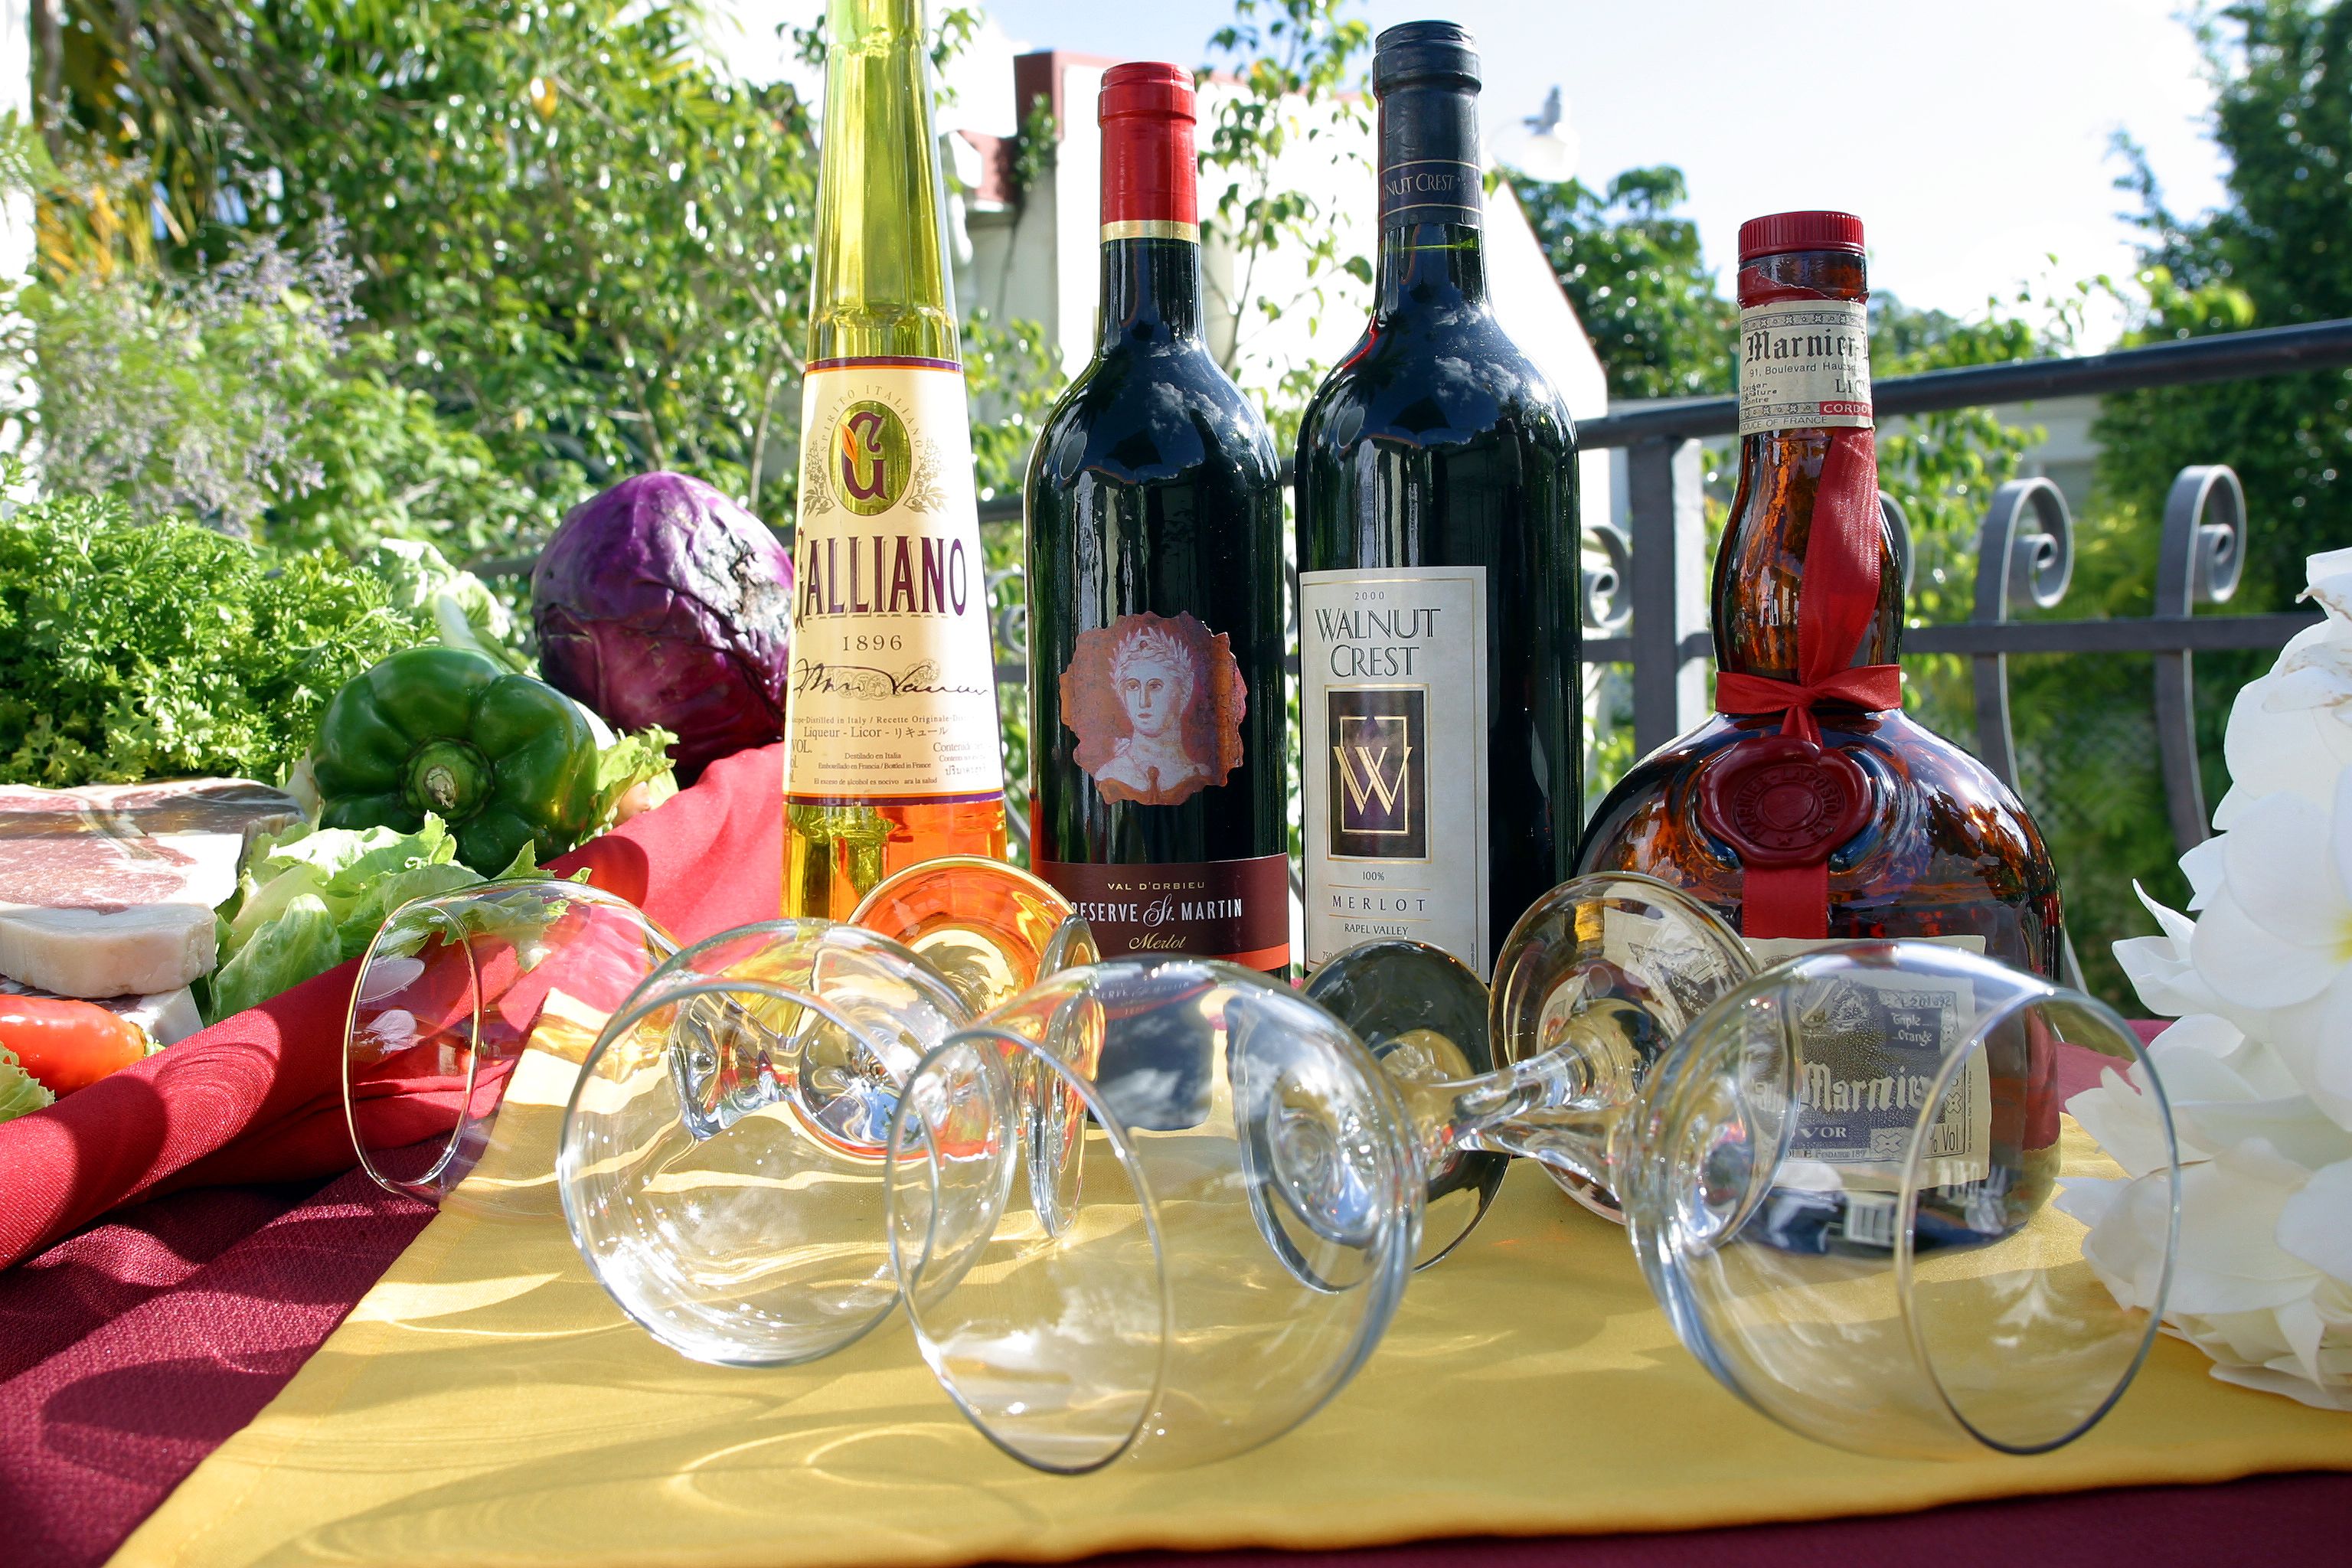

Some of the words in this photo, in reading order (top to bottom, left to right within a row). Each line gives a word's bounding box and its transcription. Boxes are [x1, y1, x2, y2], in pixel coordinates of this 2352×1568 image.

[1416, 173, 1455, 192] CREST
[1749, 368, 1762, 378] 91,
[1765, 363, 1817, 376] Boulevard
[1766, 417, 1779, 428] OF
[1783, 415, 1828, 425] FRANCE
[1354, 591, 1385, 600] 2000
[1315, 608, 1442, 643] WALNUT
[842, 635, 903, 651] 1896
[1330, 644, 1420, 678] CREST
[848, 717, 867, 725] Italy
[804, 727, 841, 740] Liqueur
[851, 727, 882, 737] Licor
[1362, 871, 1385, 881] 100%
[1138, 881, 1205, 890] D'ORBIEU
[1181, 898, 1243, 922] MARTIN
[1332, 895, 1426, 912] MERLOT
[1344, 923, 1370, 934] RAPEL
[1373, 925, 1410, 936] VALLEY
[1129, 932, 1187, 950] Merlot
[1799, 1060, 1931, 1112] Marnie
[1942, 1124, 1959, 1151] Vol
